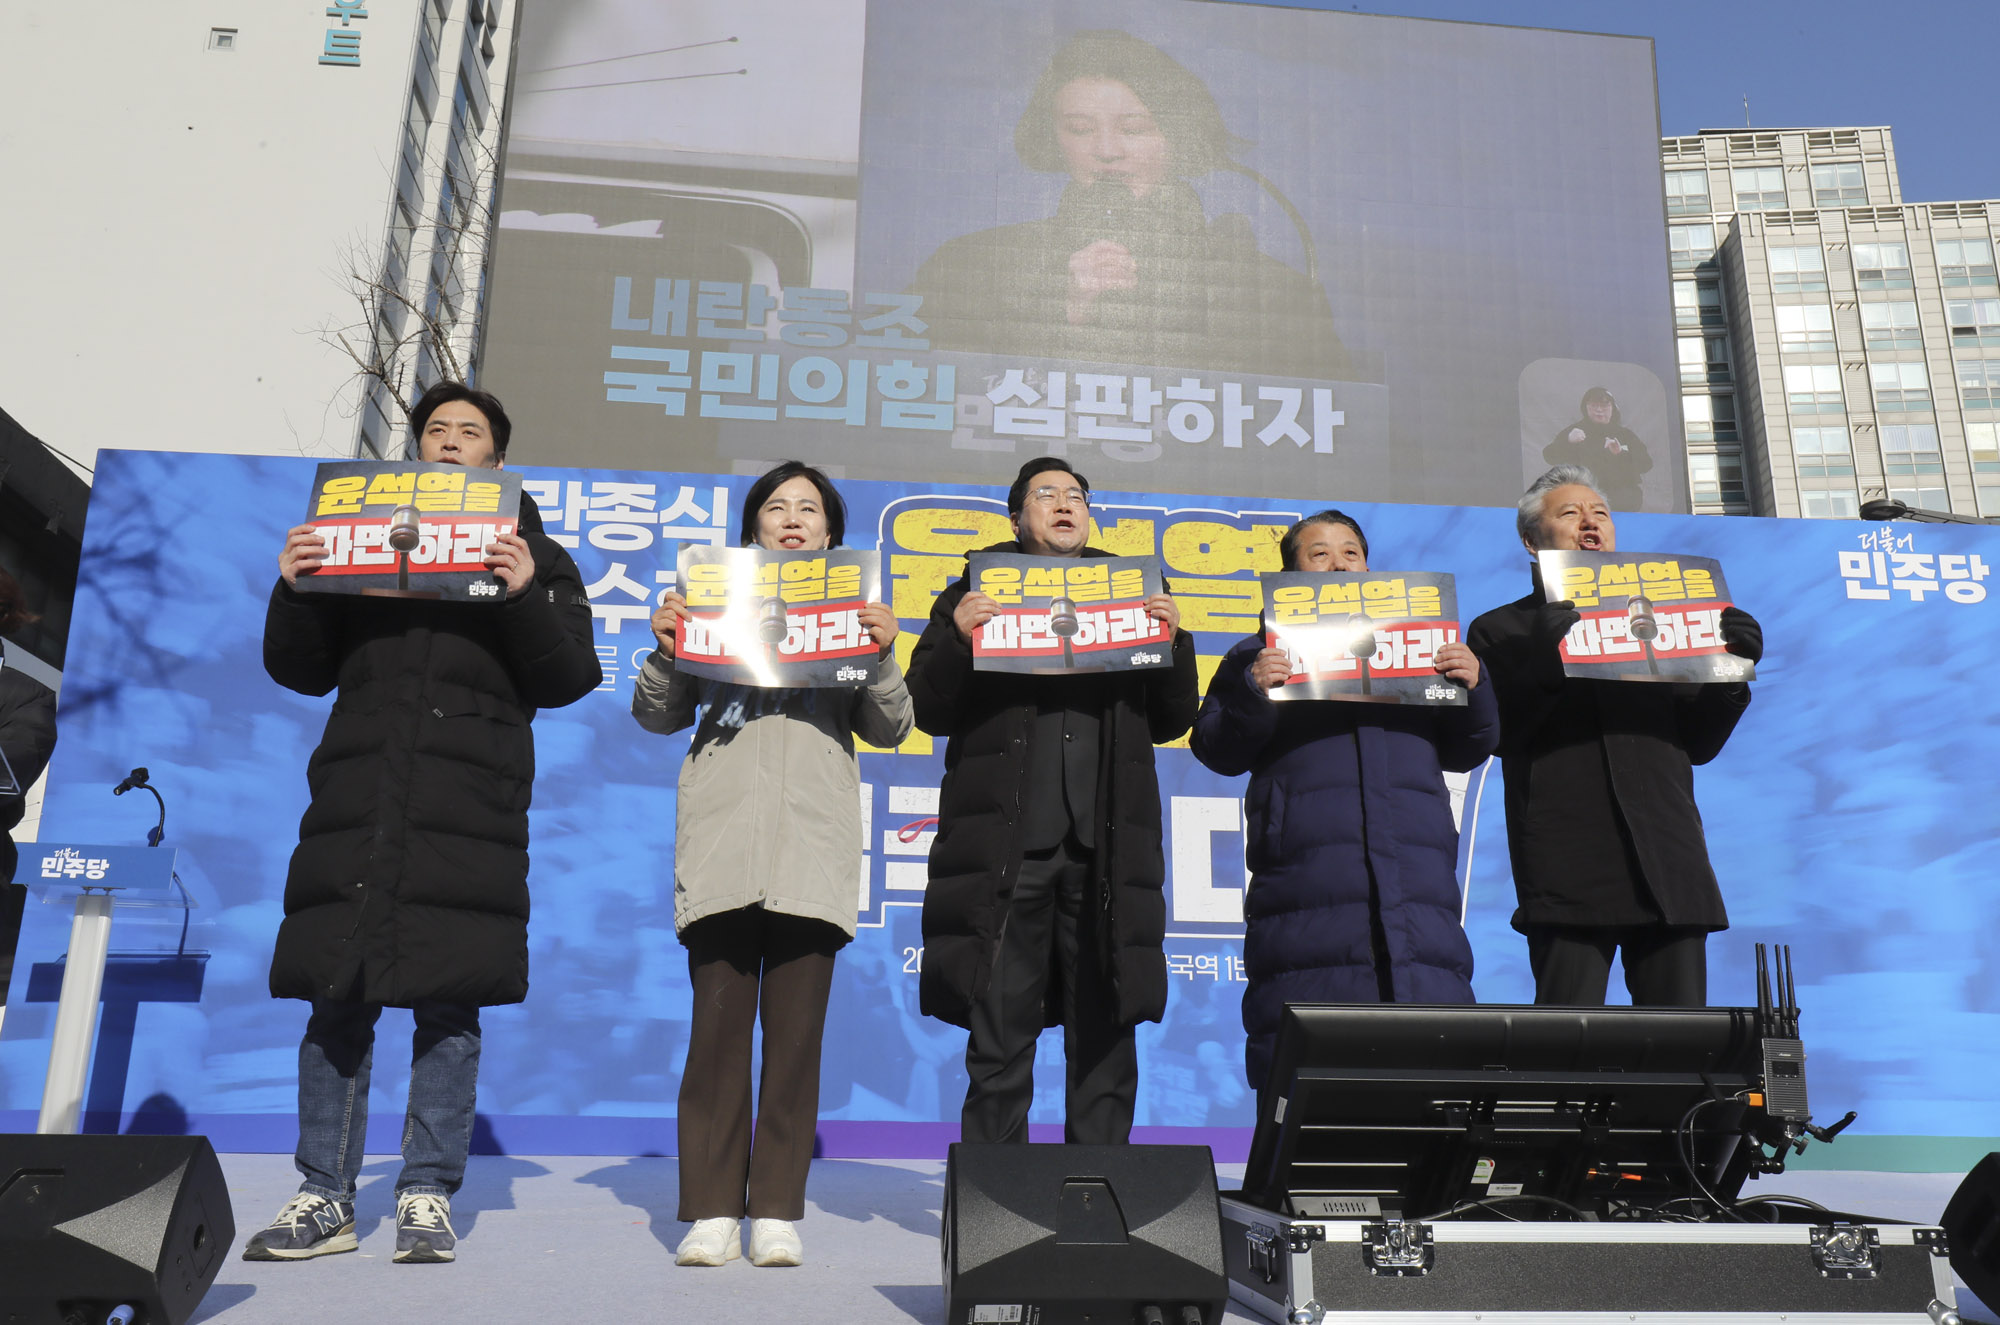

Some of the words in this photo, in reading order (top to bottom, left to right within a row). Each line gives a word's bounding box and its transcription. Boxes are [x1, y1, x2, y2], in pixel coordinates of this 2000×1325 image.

[611, 276, 930, 351] 내란동조
[604, 345, 956, 431] 국민의힘
[986, 368, 1345, 454] 심판하자
[316, 472, 502, 517] 윤석열을
[1857, 526, 1914, 555] 더불어
[469, 585, 499, 596] 민주당
[891, 508, 1289, 634] 윤열
[980, 564, 1144, 604] 윤석열을
[1560, 560, 1717, 608] 윤석열을
[1838, 551, 1990, 604] 민주당
[1273, 578, 1441, 625] 윤석열을
[837, 669, 868, 681] 민주당
[1131, 654, 1162, 665] 민주당
[1424, 688, 1456, 700] 민주당
[41, 857, 110, 880] 민주당
[1165, 954, 1219, 981] 국역
